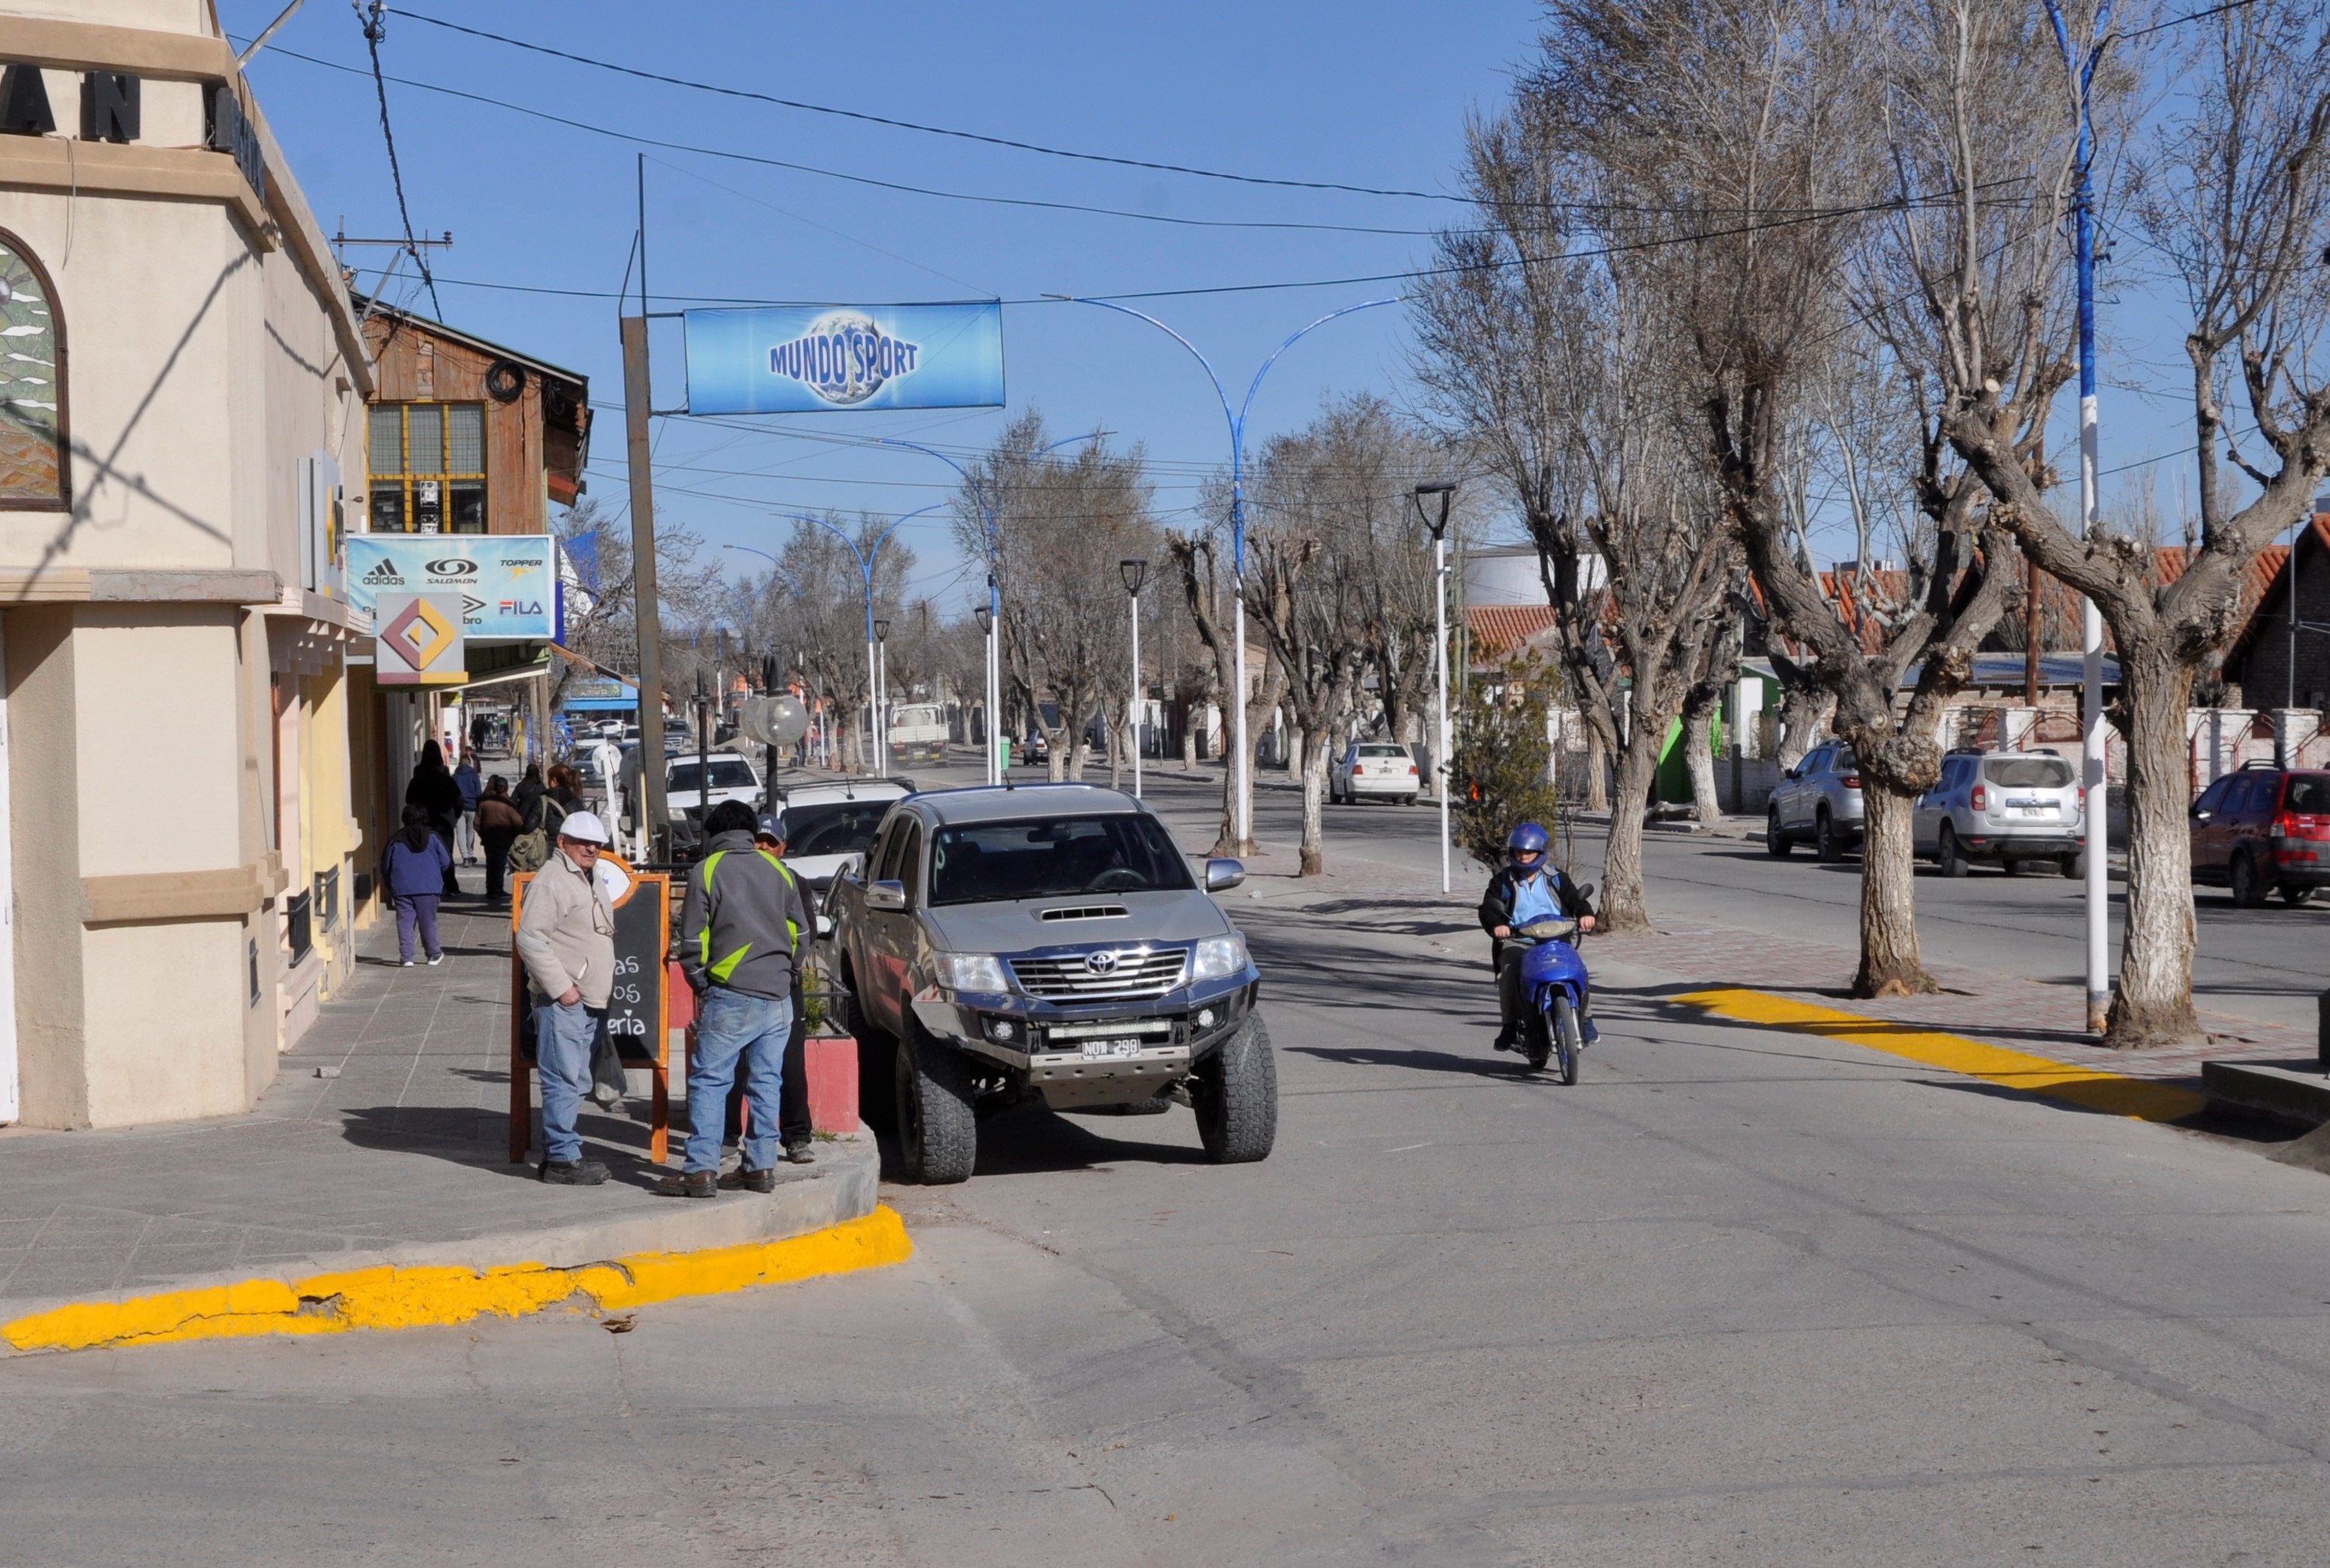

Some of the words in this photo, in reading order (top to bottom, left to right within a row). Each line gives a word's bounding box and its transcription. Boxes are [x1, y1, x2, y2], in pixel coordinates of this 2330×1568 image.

[769, 333, 847, 385] MUNDO
[852, 332, 918, 384] SPORT
[499, 559, 543, 567] TOPPER
[362, 574, 405, 586] adidas
[499, 600, 544, 615] FILA
[463, 615, 482, 625] bro
[614, 955, 639, 975] as
[613, 983, 641, 1003] os
[607, 1008, 646, 1036] eria
[1113, 1039, 1138, 1054] 298
